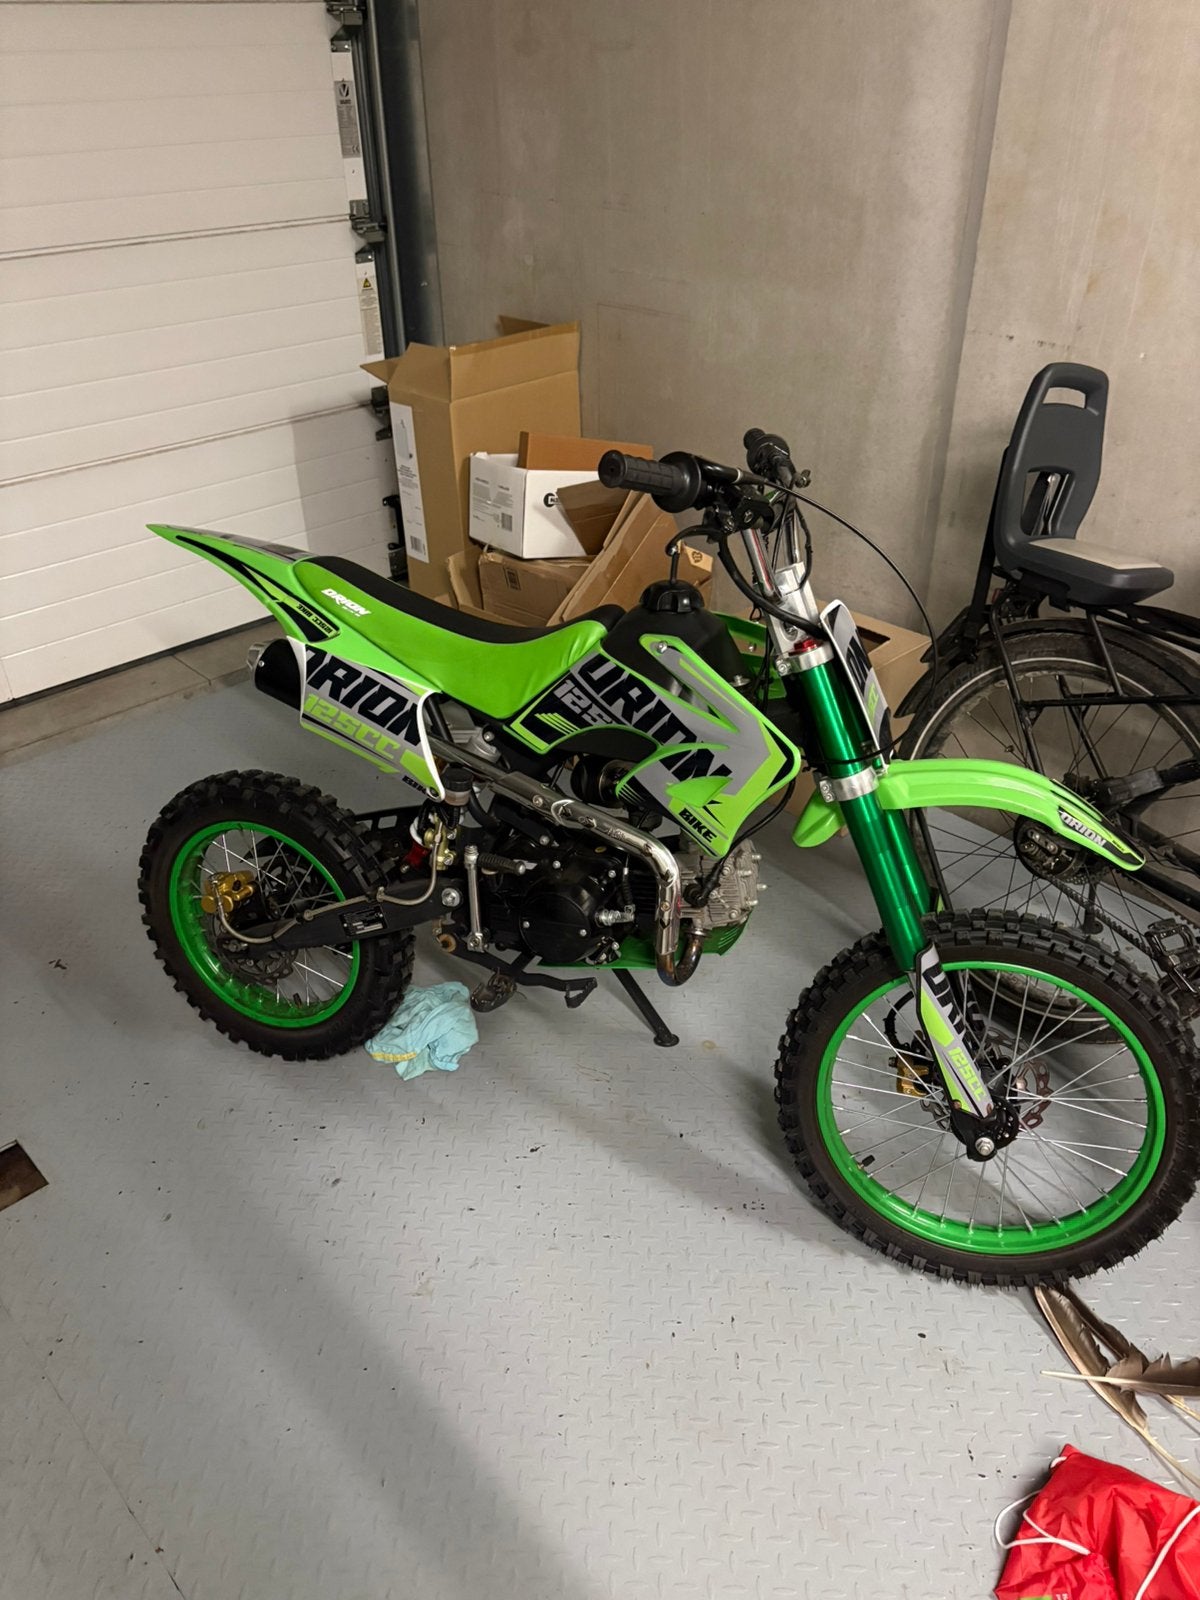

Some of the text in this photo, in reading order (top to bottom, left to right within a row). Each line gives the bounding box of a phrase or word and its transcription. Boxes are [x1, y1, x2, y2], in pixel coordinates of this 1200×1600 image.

[303, 693, 401, 760] 125CC
[578, 653, 733, 783] ORION
[402, 775, 428, 796] BIK
[679, 808, 718, 843] BIKE
[1058, 810, 1107, 847] ORION
[949, 1046, 987, 1103] 125CC
